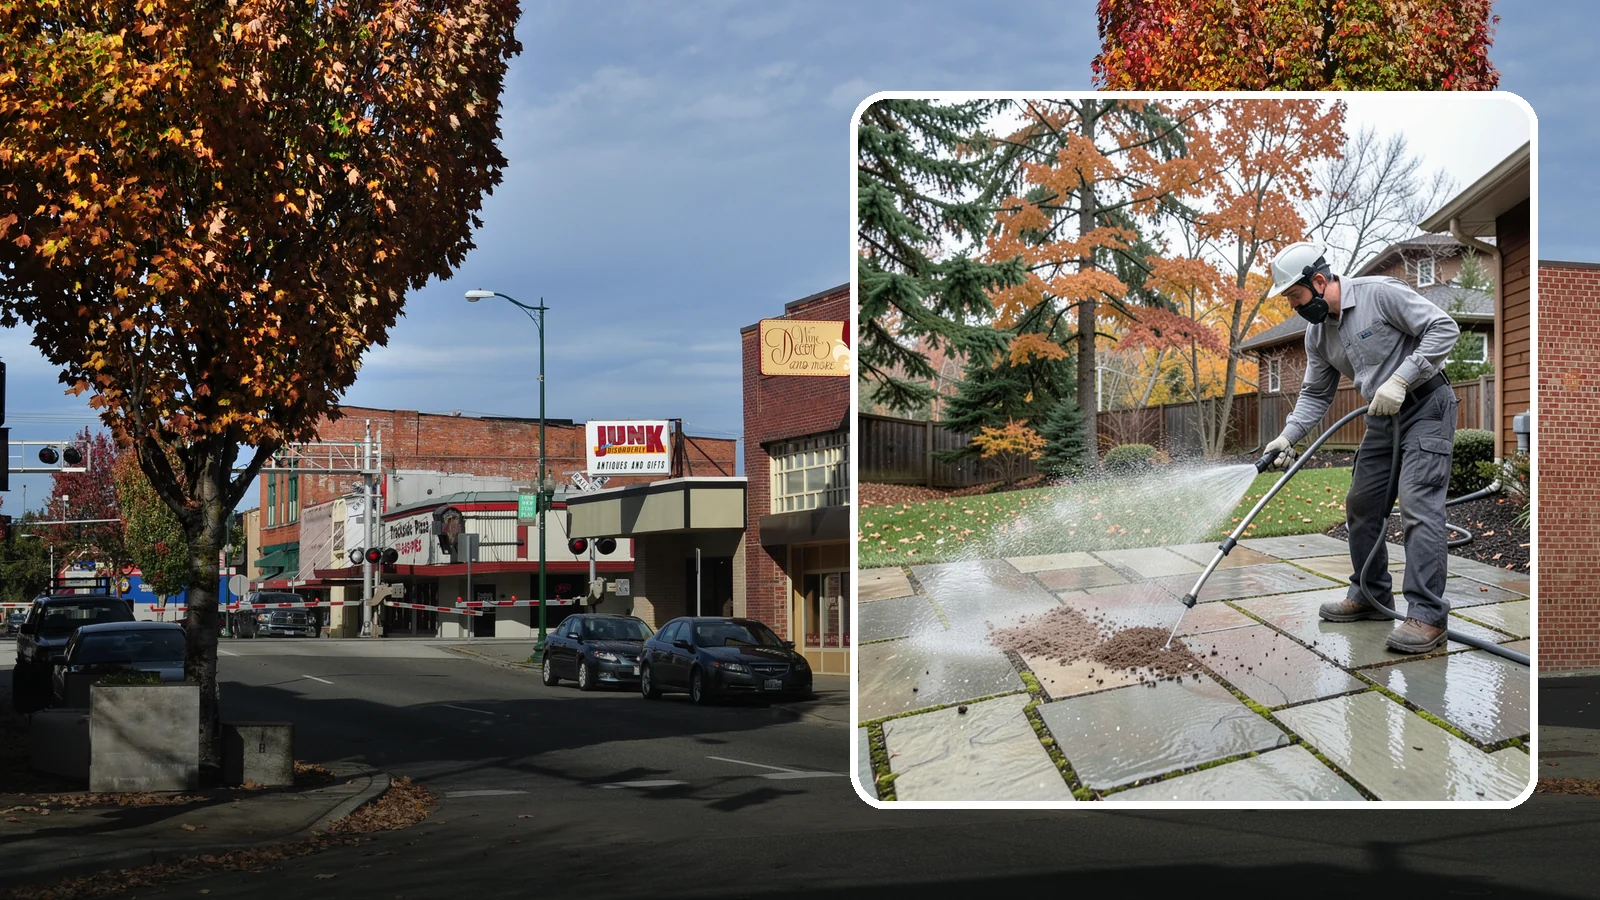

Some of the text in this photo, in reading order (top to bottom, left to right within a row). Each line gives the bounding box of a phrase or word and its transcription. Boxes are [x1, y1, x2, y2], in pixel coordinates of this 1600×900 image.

[595, 425, 664, 457] JUNK
[608, 446, 646, 454] DISORDERLY
[597, 461, 665, 470] ANTIQUES AND GIFTS
[390, 519, 429, 540] Trackside Pizza
